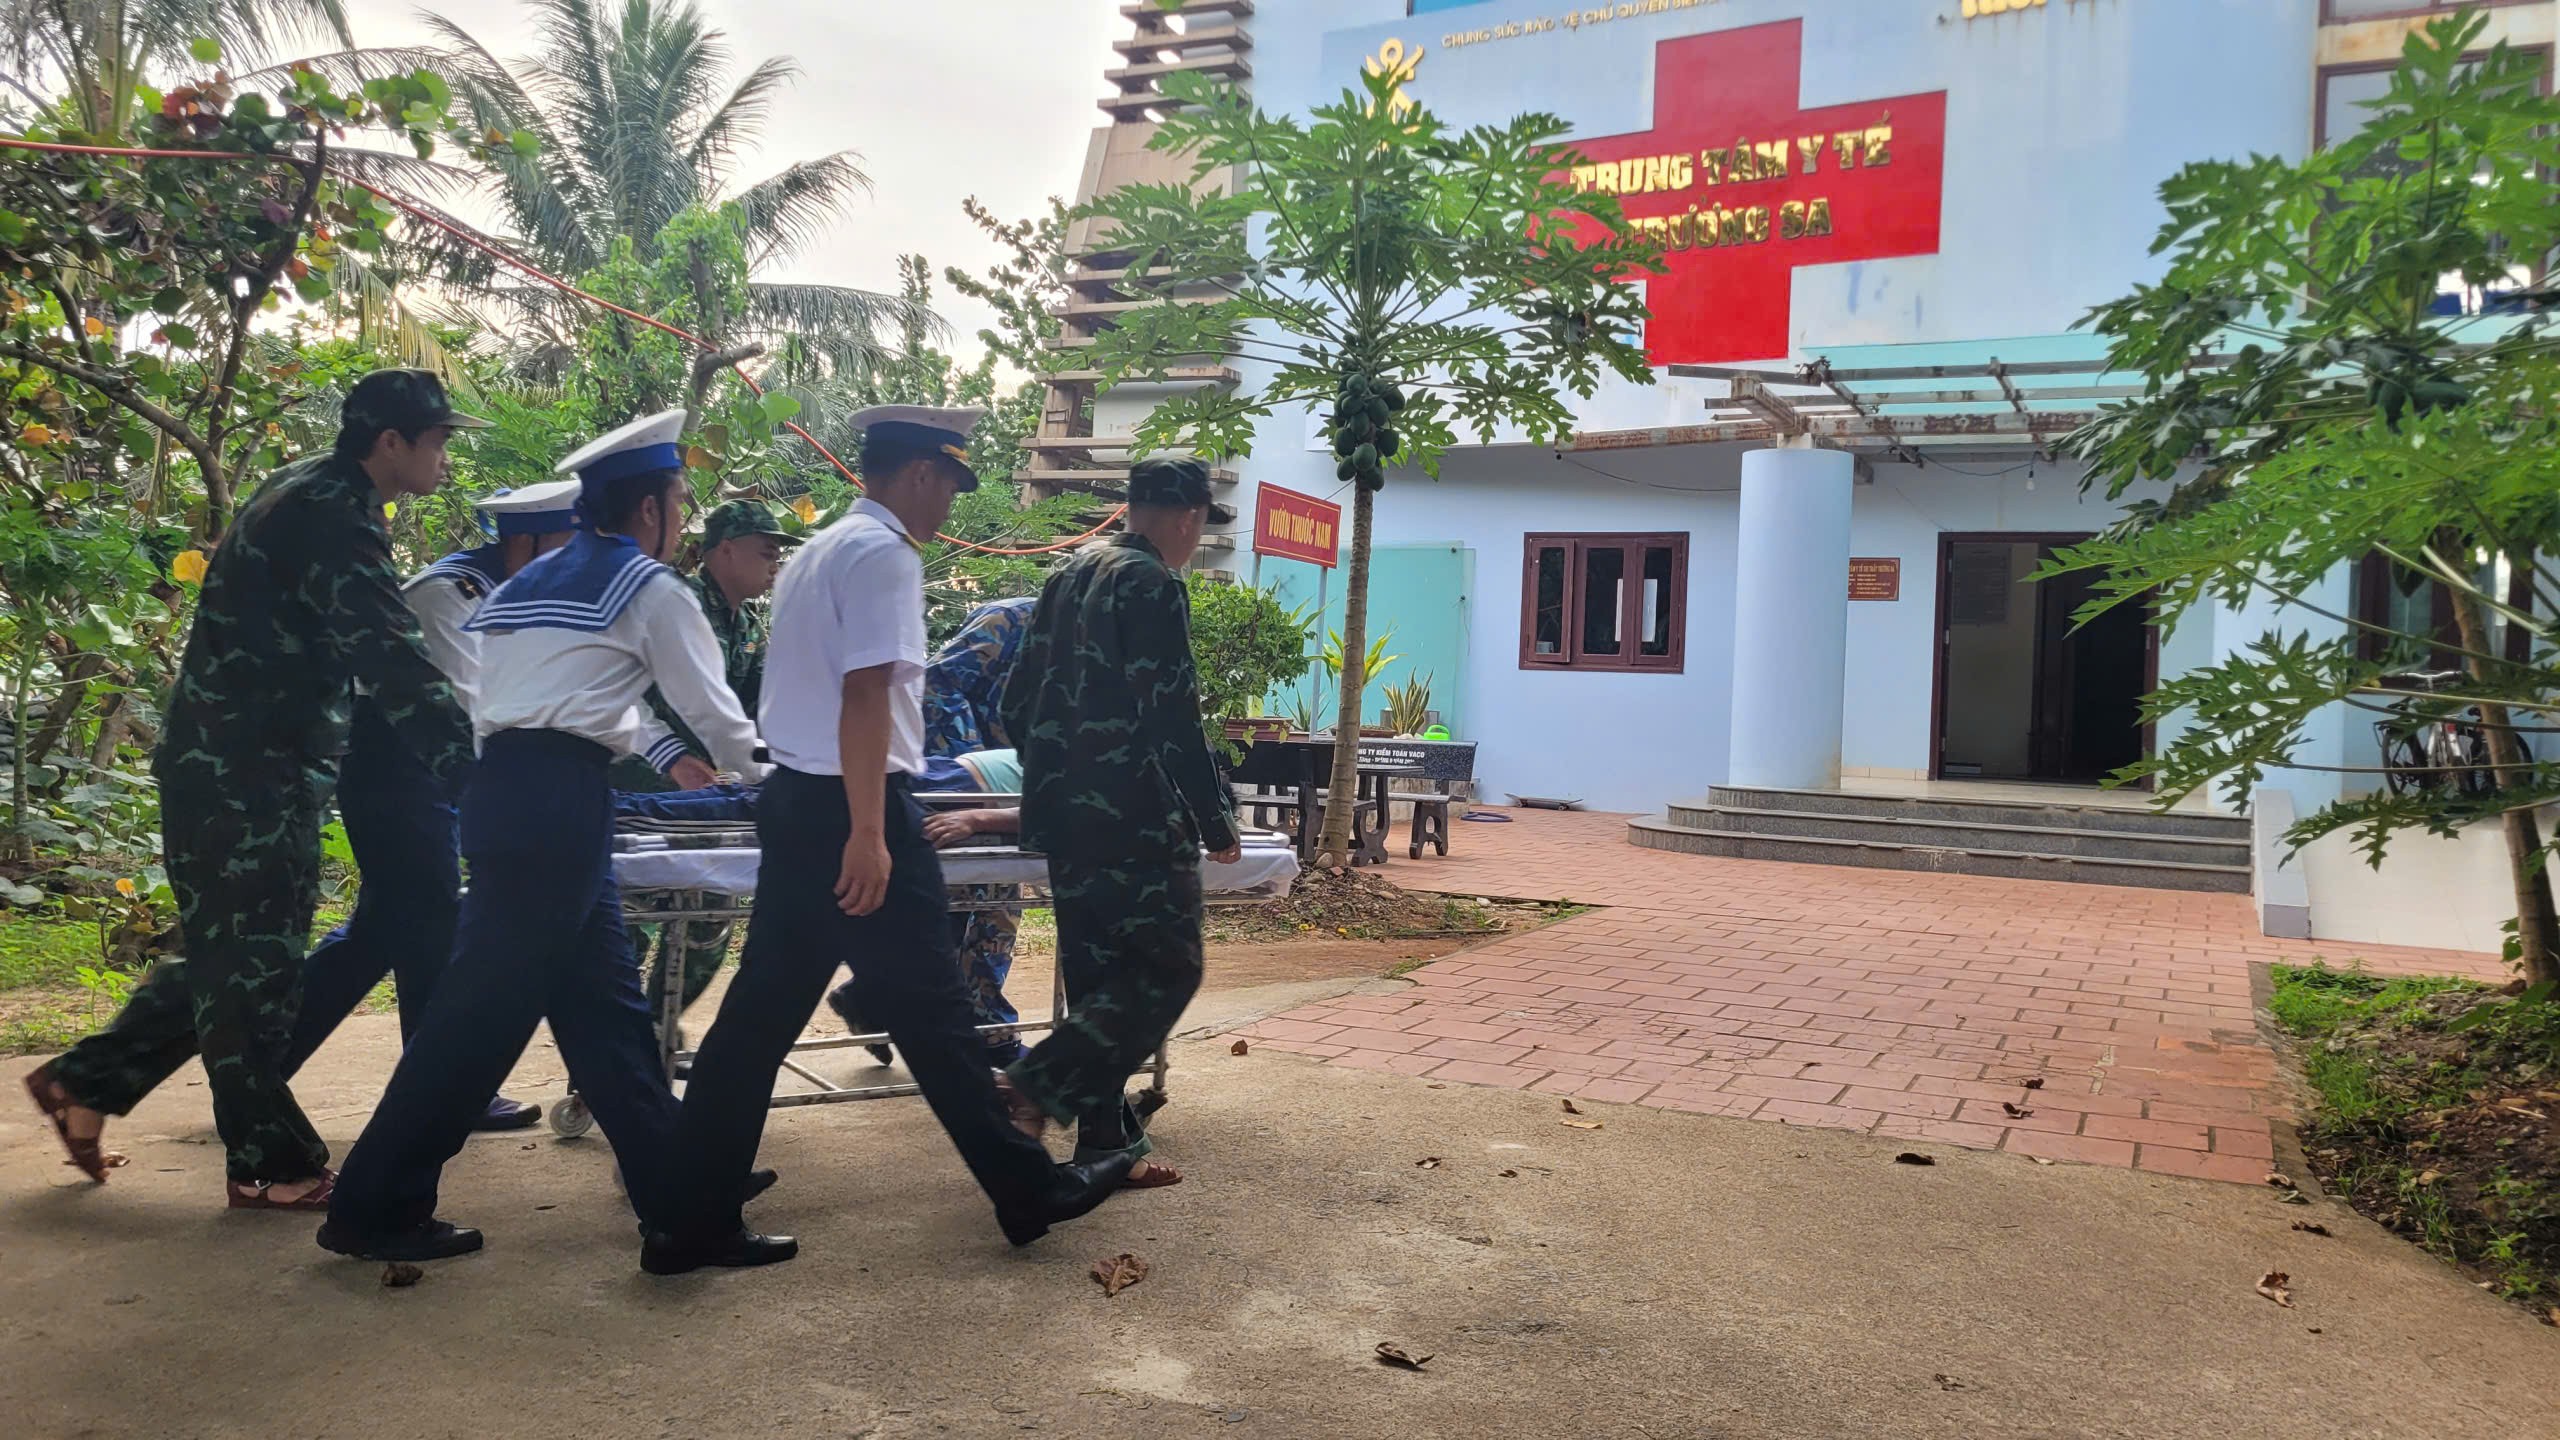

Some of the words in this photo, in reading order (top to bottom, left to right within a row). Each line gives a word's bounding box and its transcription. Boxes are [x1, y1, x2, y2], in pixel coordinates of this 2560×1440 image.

[1440, 29, 1490, 49] CHUNG
[1569, 152, 1693, 198] TRUNG
[1702, 136, 1789, 186] TÂM
[1797, 134, 1825, 175] Y
[1833, 109, 1893, 170] TẾ
[1780, 197, 1832, 240] SA
[1268, 502, 1291, 540] VƯỜN
[1291, 508, 1315, 545] THUỐC
[1315, 520, 1332, 550] NAM
[1368, 748, 1375, 756] TY
[1408, 751, 1425, 759] VACO
